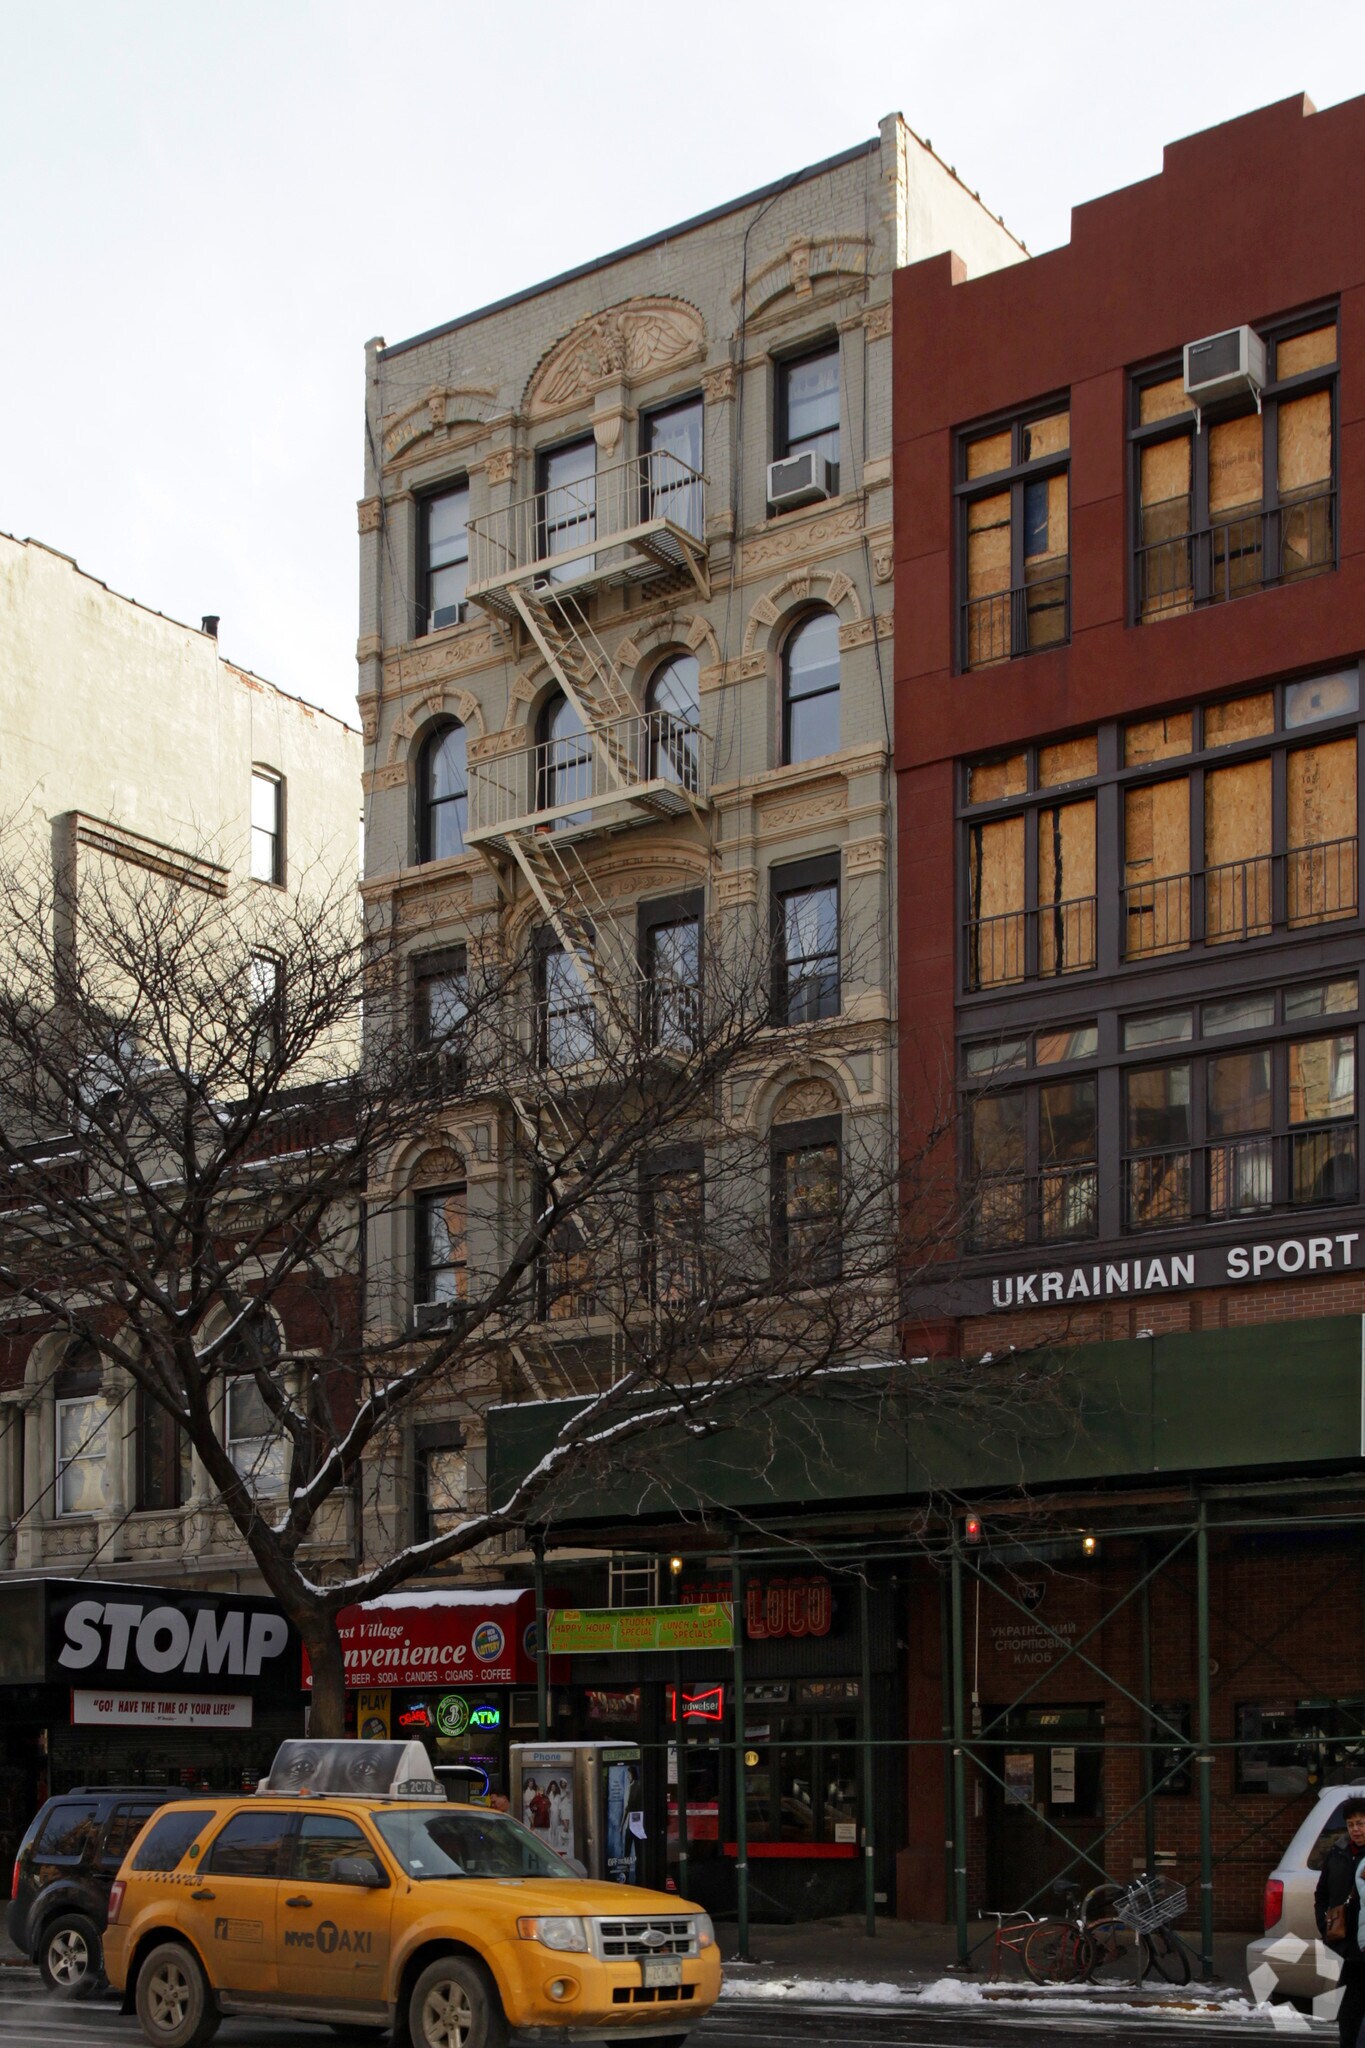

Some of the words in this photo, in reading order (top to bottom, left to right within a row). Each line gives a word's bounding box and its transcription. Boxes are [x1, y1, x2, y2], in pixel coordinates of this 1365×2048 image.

[992, 1254, 1195, 1308] UKRAINIAN
[1226, 1233, 1360, 1280] SPORT
[746, 1576, 831, 1639] LOCO
[555, 1623, 582, 1633] HAPPY
[585, 1623, 611, 1633] HOUR
[619, 1617, 656, 1627] STUDENT
[662, 1621, 689, 1631] LUNCH
[692, 1620, 698, 1629] &
[702, 1618, 722, 1628] LATE
[57, 1600, 289, 1676] STOMP
[338, 1626, 355, 1639] ast
[359, 1623, 404, 1640] Village
[620, 1628, 652, 1636] SPECIAL
[673, 1629, 713, 1639] SPECIALS
[343, 1639, 467, 1668] nvenience
[351, 1673, 371, 1685] BEER
[377, 1672, 398, 1684] SODA
[405, 1671, 438, 1683] CANDIES
[445, 1669, 473, 1682] CIGARS
[481, 1668, 512, 1681] COFFEE
[118, 1700, 139, 1713] HAVE
[141, 1701, 156, 1714] THE
[157, 1701, 176, 1714] TIME
[178, 1702, 188, 1715] OF
[191, 1702, 211, 1715] YOUR
[361, 1695, 387, 1711] PLAY
[682, 1701, 719, 1711] udweiser
[469, 1710, 500, 1725] ATM
[533, 1753, 561, 1761] Phone
[604, 1750, 639, 1760] TELEPHONE
[410, 1781, 432, 1793] 2C78
[284, 1930, 315, 1948] NYC
